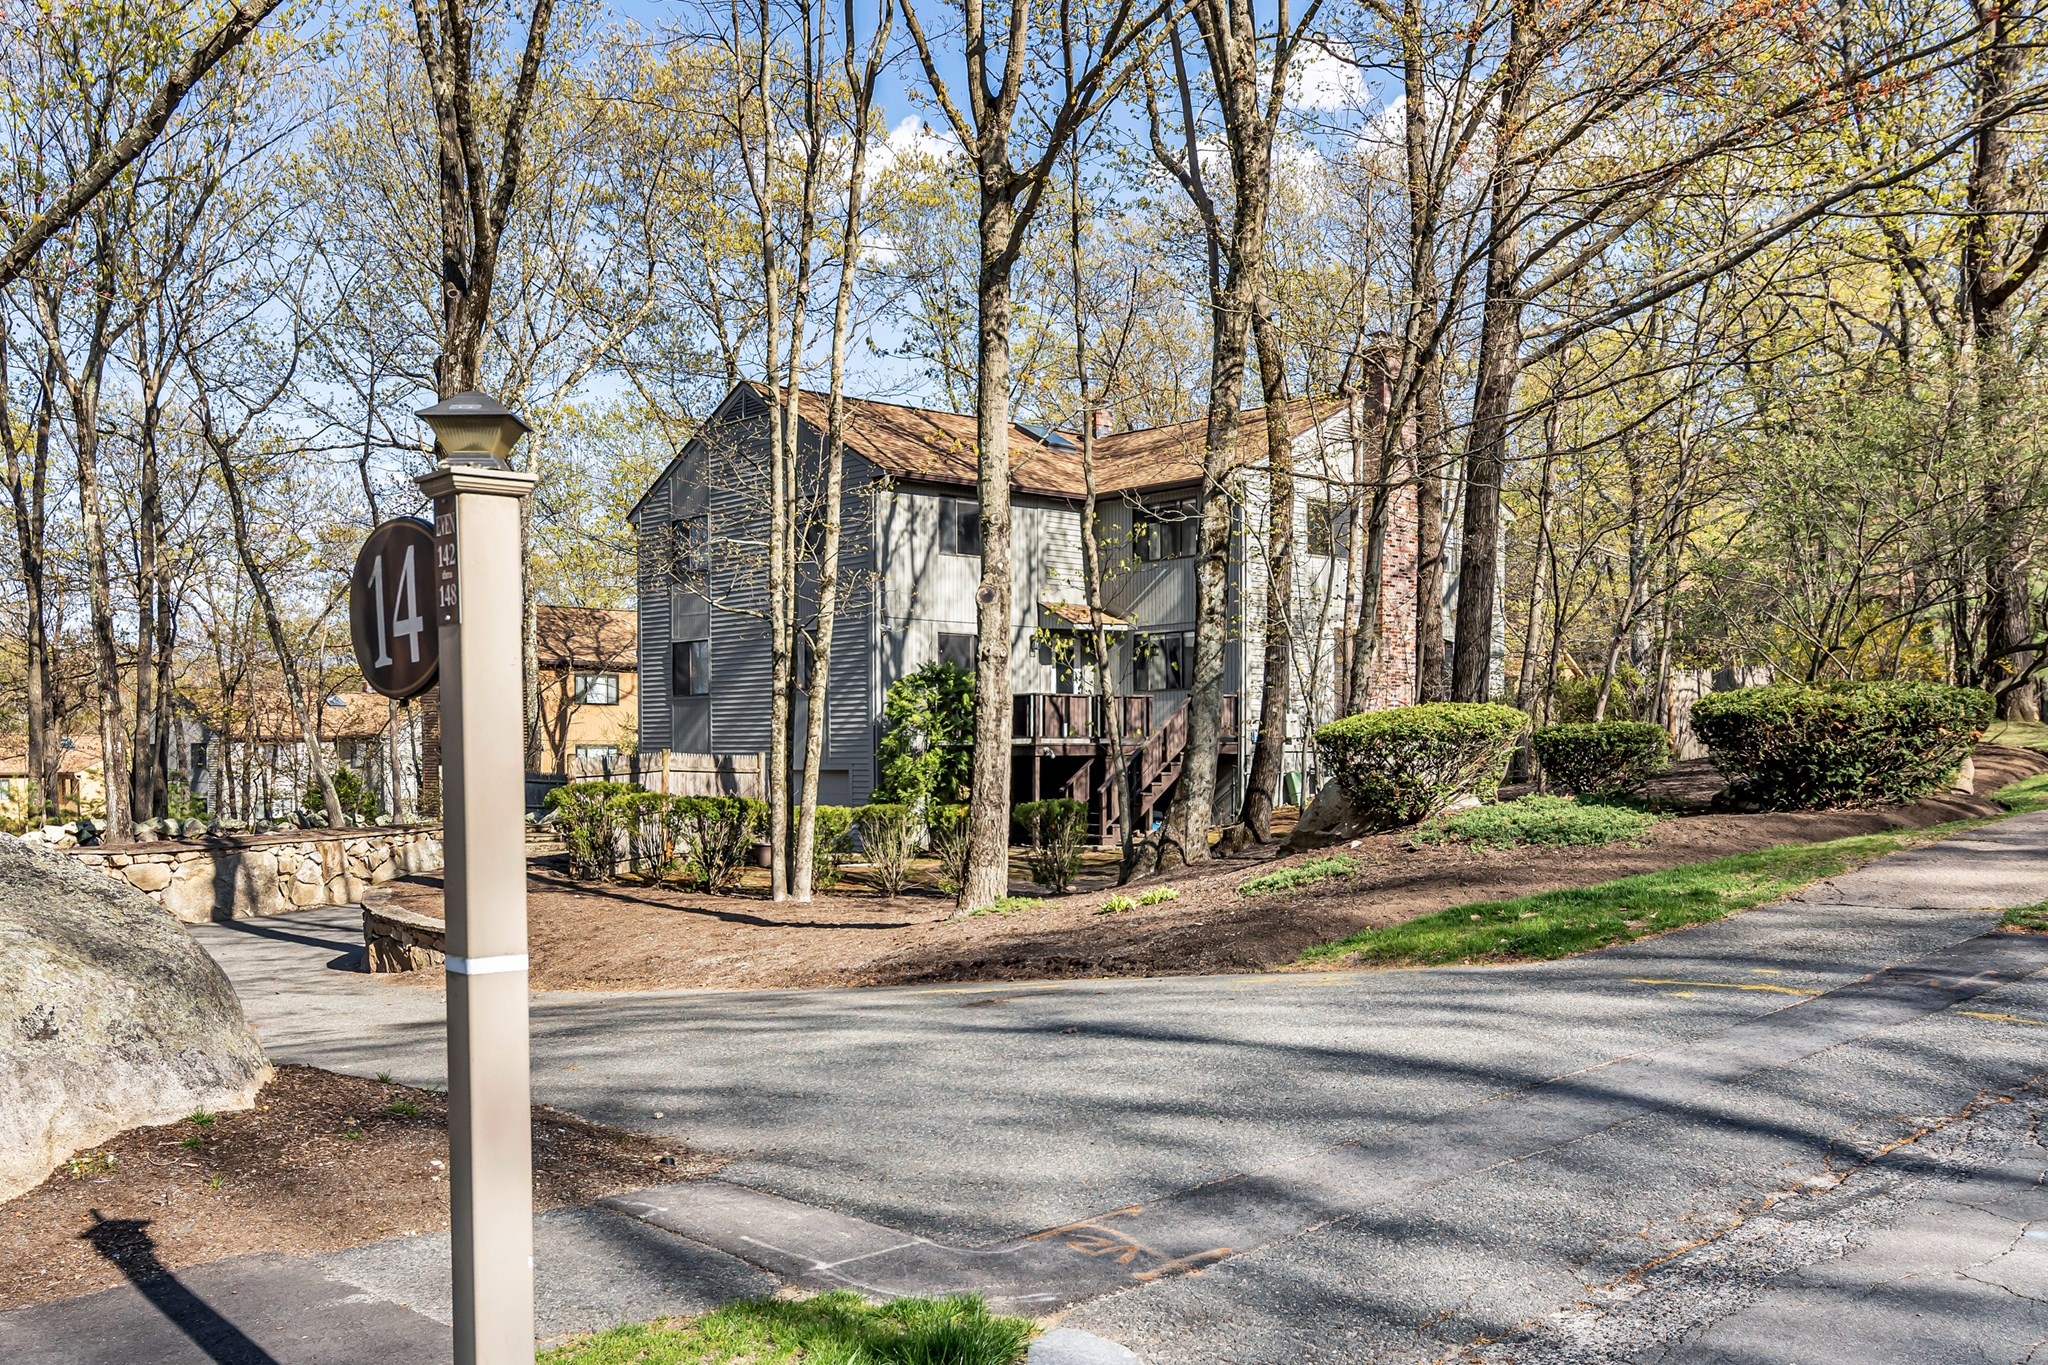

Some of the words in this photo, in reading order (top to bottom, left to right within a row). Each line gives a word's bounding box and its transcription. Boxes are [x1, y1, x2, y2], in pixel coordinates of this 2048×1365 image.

[436, 512, 456, 537] EVEN
[438, 543, 456, 567] 142
[367, 545, 424, 669] 14
[439, 583, 457, 607] 148
